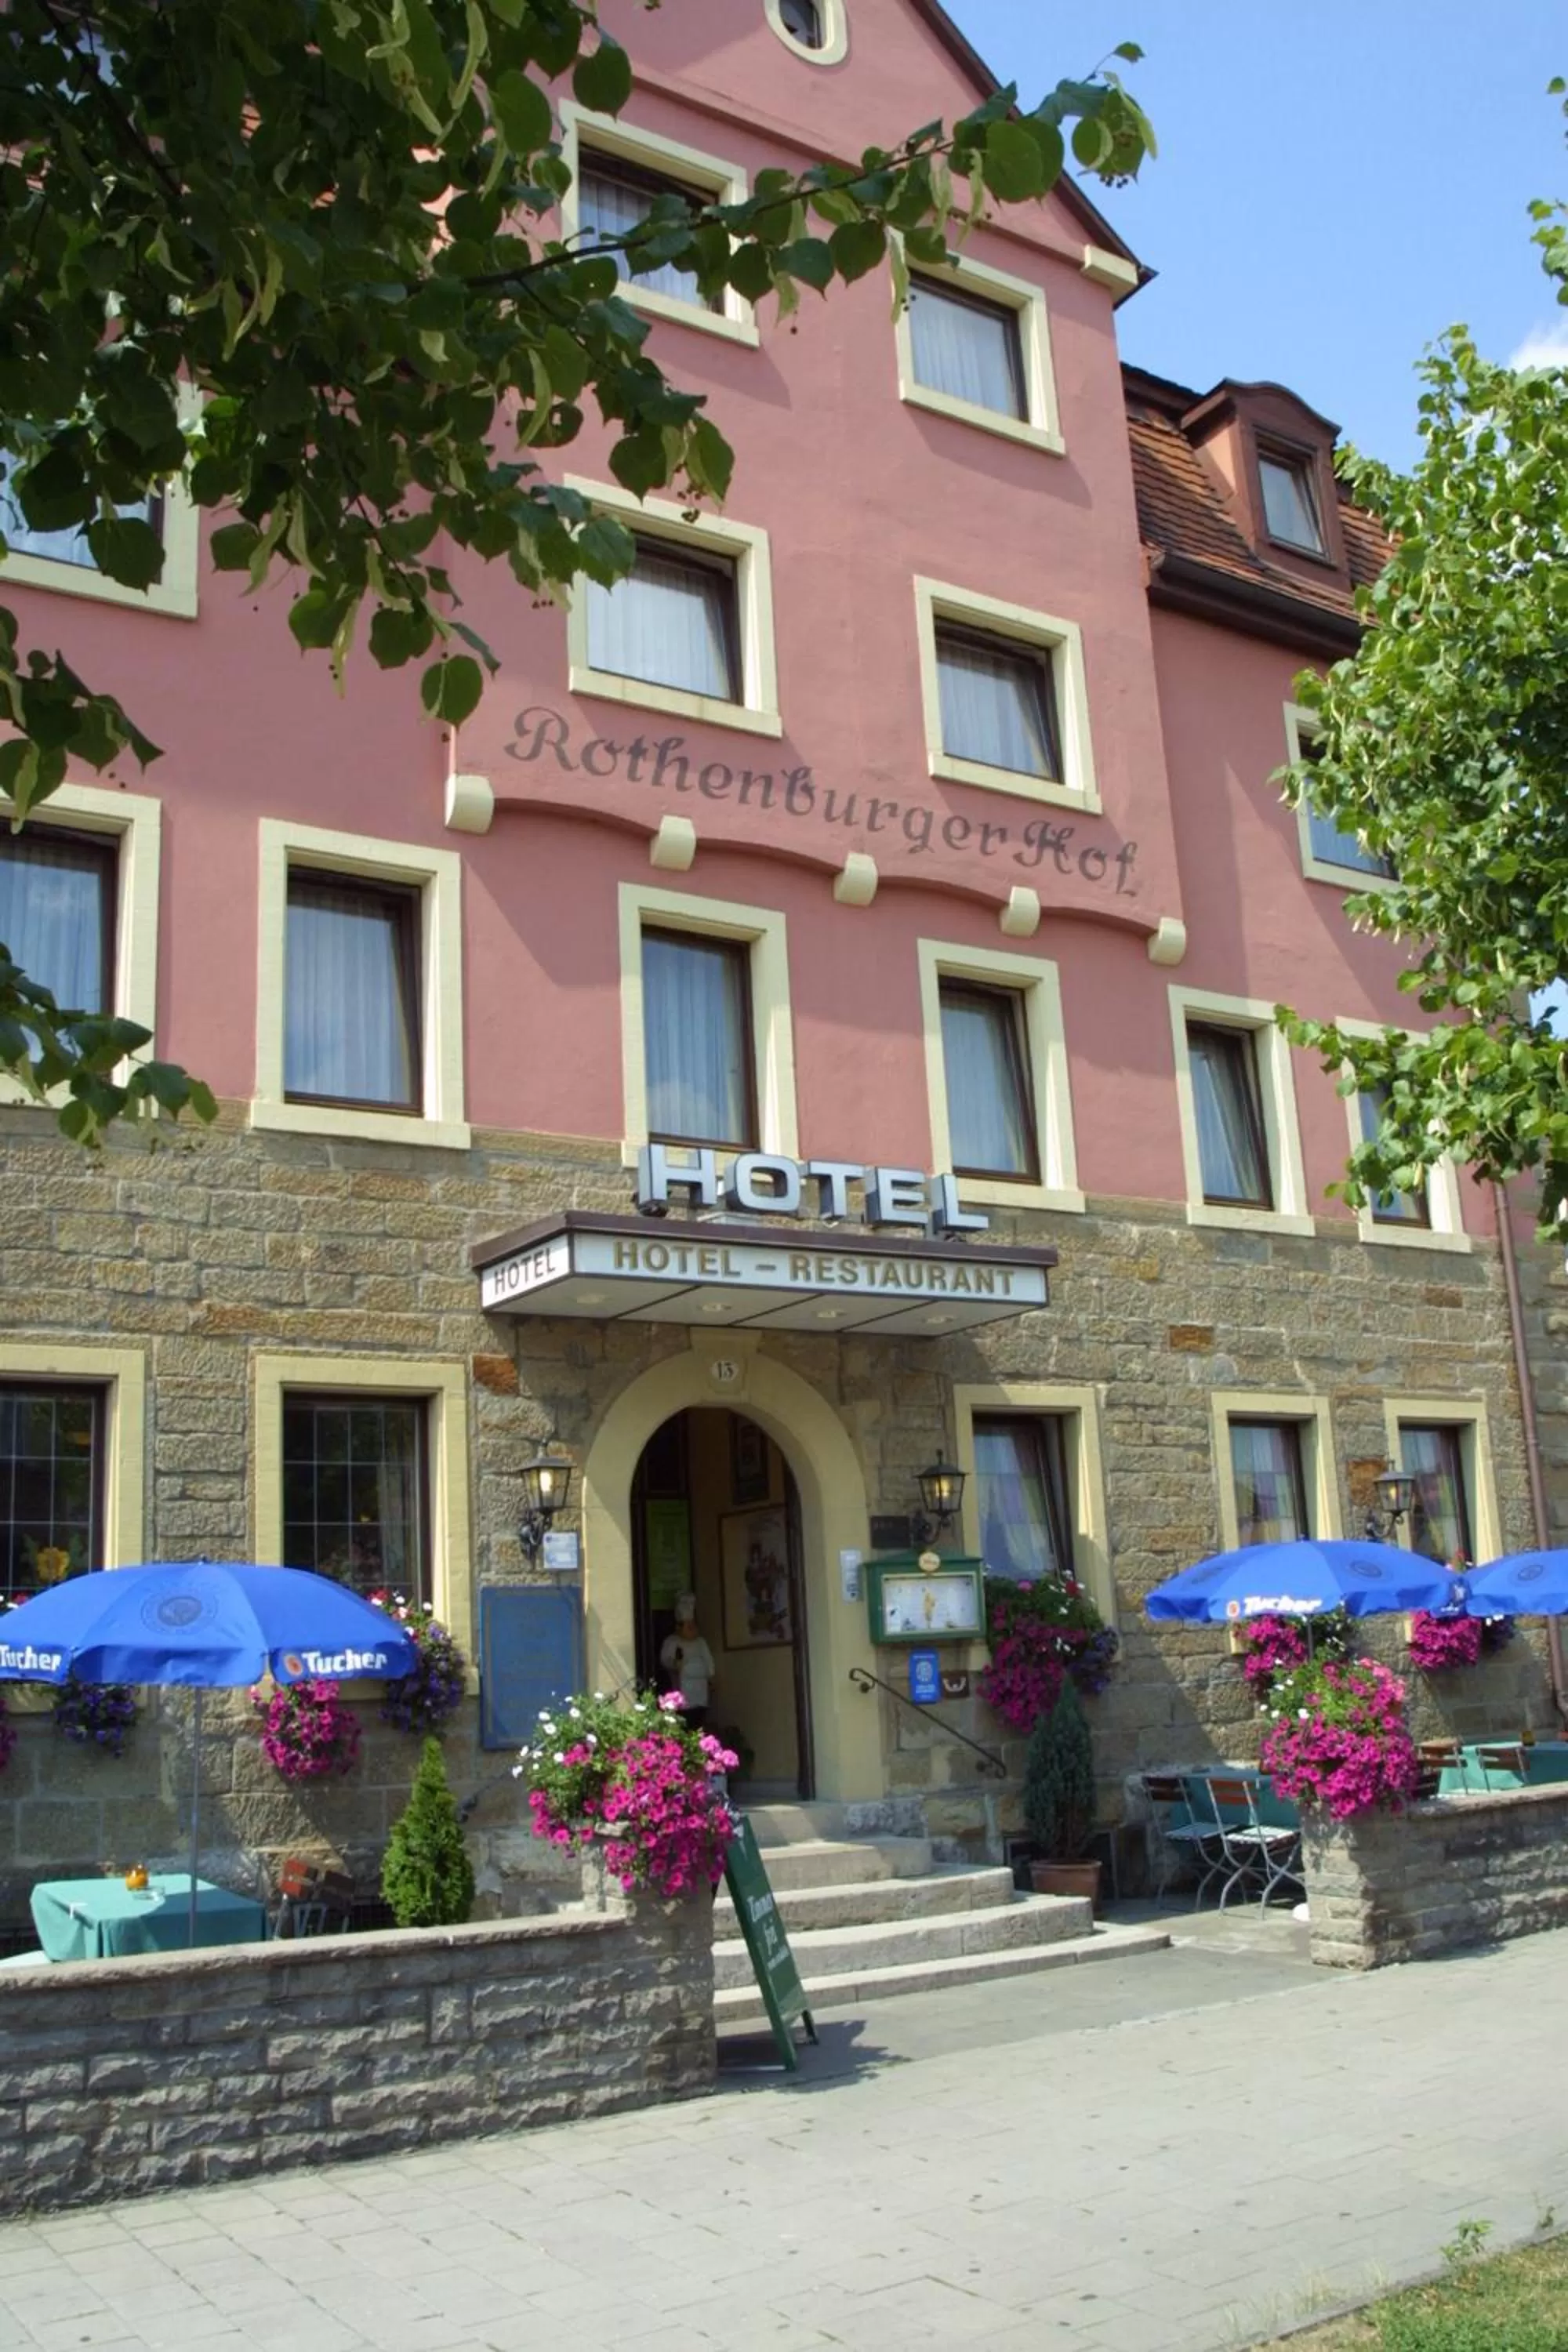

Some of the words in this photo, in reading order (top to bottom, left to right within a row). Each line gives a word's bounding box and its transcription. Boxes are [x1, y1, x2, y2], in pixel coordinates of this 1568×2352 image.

[504, 706, 1007, 856] Rothenburger
[1013, 820, 1138, 896] Hof
[638, 1144, 989, 1232] HOTEL
[493, 1247, 557, 1297] HOTEL
[613, 1238, 742, 1278] HOTEL
[789, 1253, 1015, 1296] RESTAURANT
[0, 1644, 62, 1671] Tucher
[302, 1648, 388, 1675] Tucher
